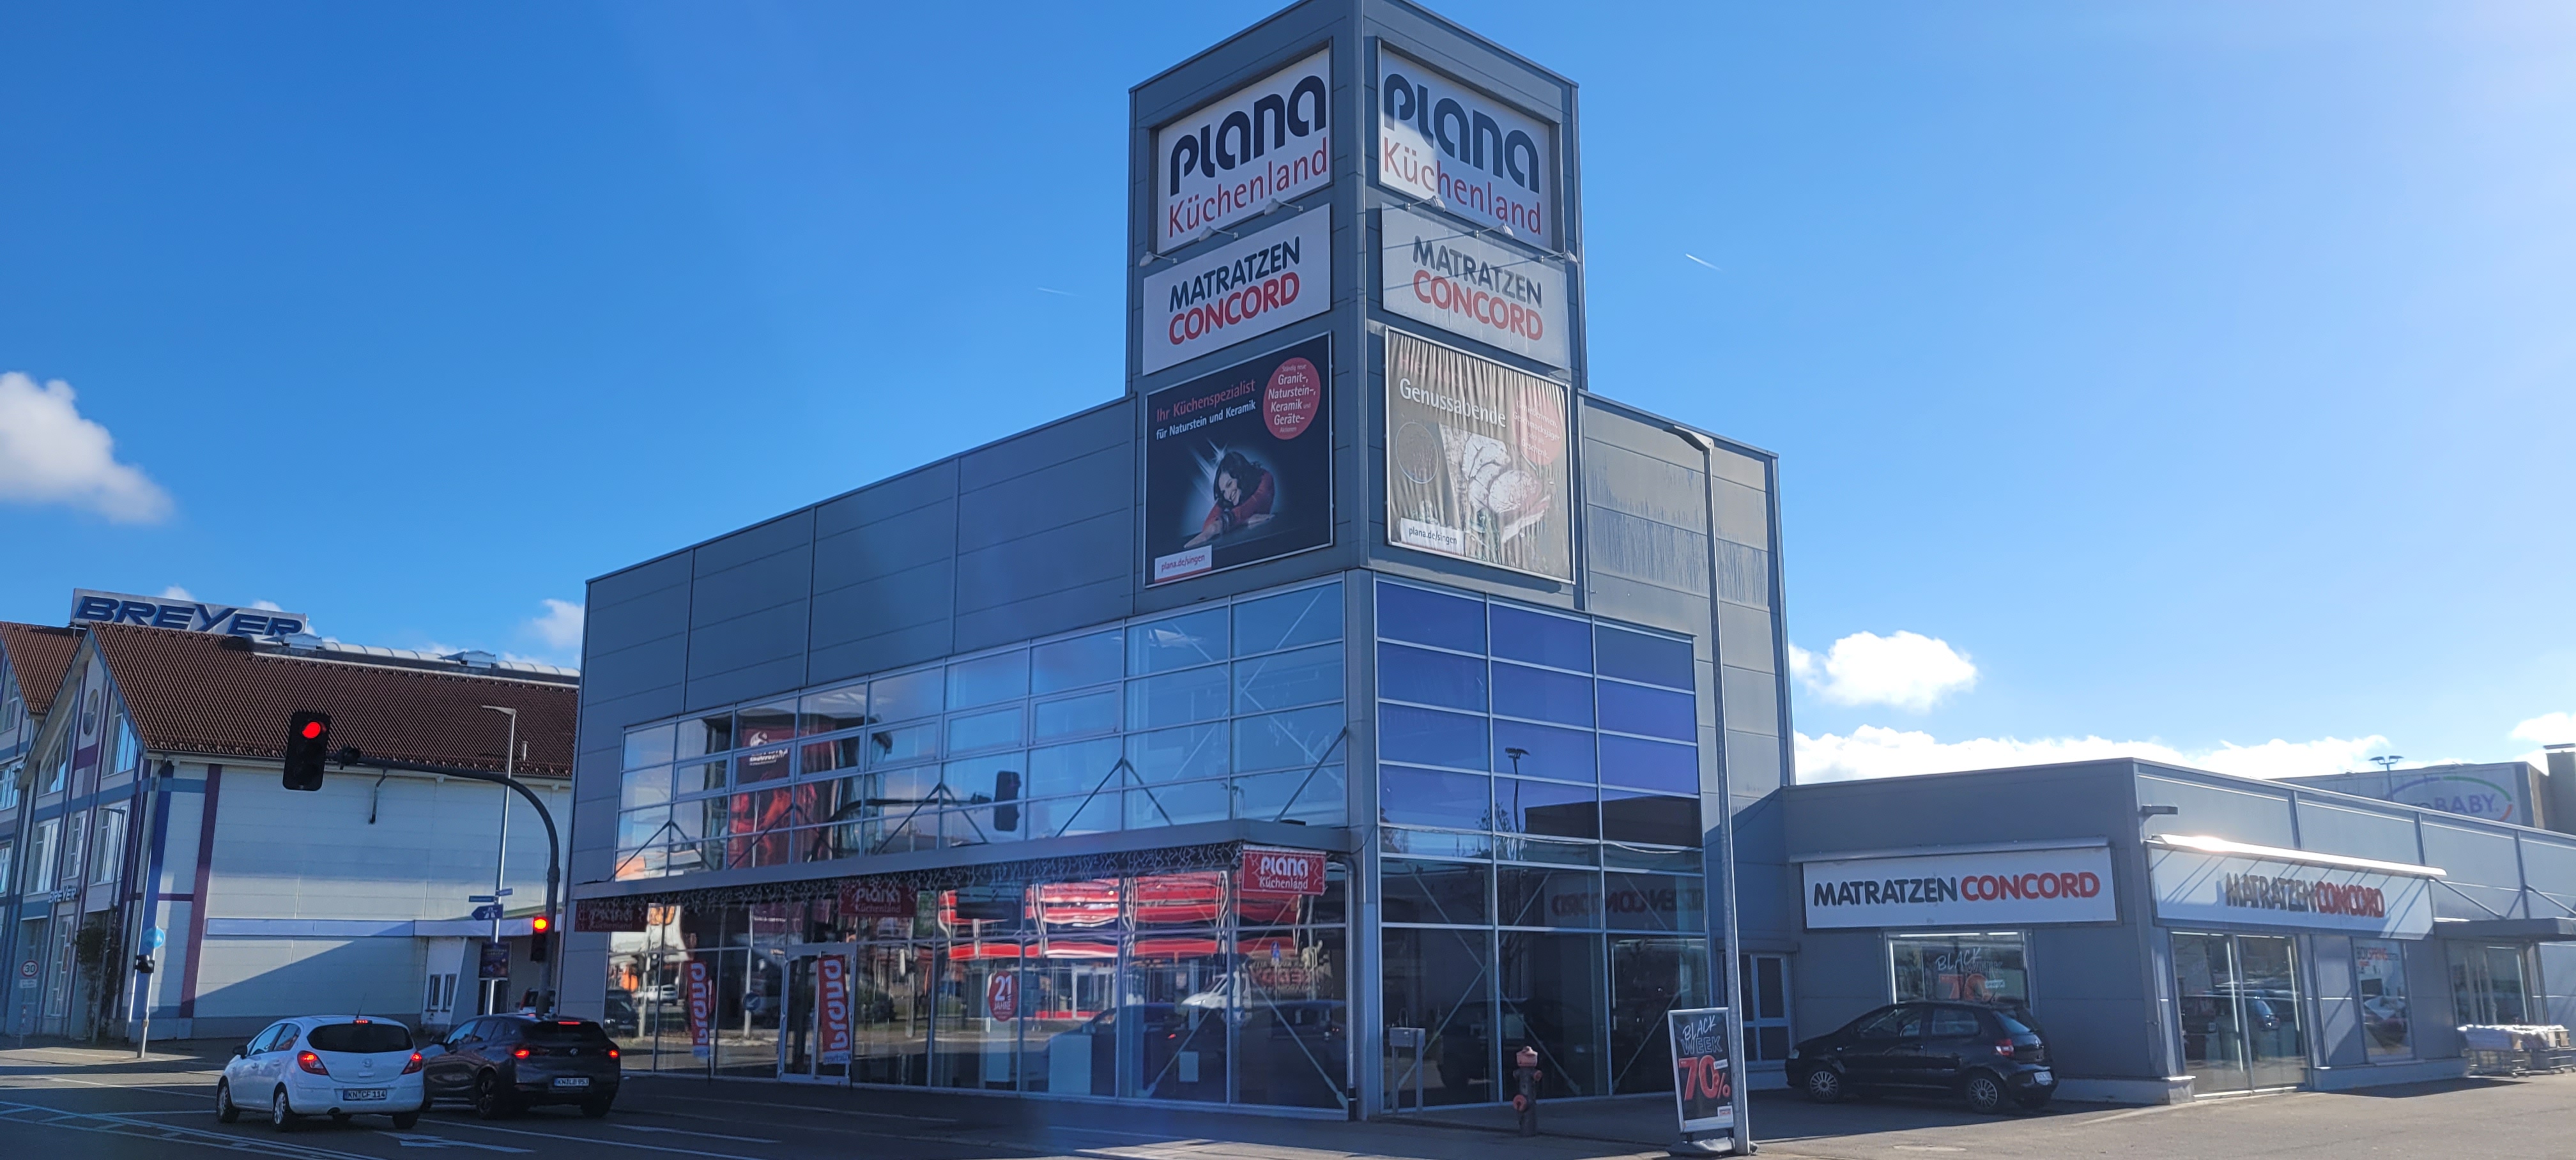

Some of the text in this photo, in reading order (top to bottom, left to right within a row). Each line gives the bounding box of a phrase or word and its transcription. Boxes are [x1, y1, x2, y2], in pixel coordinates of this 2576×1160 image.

[1170, 75, 1326, 197] plana
[1384, 73, 1540, 194] plana
[1169, 136, 1327, 238] Küchenland
[1384, 136, 1541, 235] Küchenland
[1169, 236, 1300, 313] MATRATZEN
[1413, 235, 1542, 309] MATRATZEN
[1169, 272, 1300, 345] CONCORD
[1413, 270, 1543, 341] CONCORD
[1268, 385, 1316, 401] Naturstein-,
[1278, 372, 1308, 385] Granit-,
[1156, 378, 1256, 422] Ihr Küchenspezialist
[1270, 398, 1303, 413] Keramik
[1400, 378, 1506, 427] Genussabende
[1156, 399, 1256, 440] für Naturstein und Keramik
[1274, 413, 1305, 425] Geräte-
[1409, 526, 1457, 545] plana.de/singen
[1161, 554, 1205, 572] plana.de/singen
[75, 596, 303, 636] BREYER
[1259, 876, 1308, 889] Küchenland
[1261, 857, 1308, 877] plana
[1814, 872, 2100, 906] MATRATZEN CONCORD
[2226, 872, 2385, 918] MATRATZEN CONCORD
[24, 965, 36, 973] 30
[1935, 947, 1981, 970] BLACK
[995, 975, 1012, 1001] 21
[1680, 1035, 1722, 1055] WEEK
[1682, 1014, 1717, 1041] BLACK
[1678, 1055, 1731, 1101] 70%
